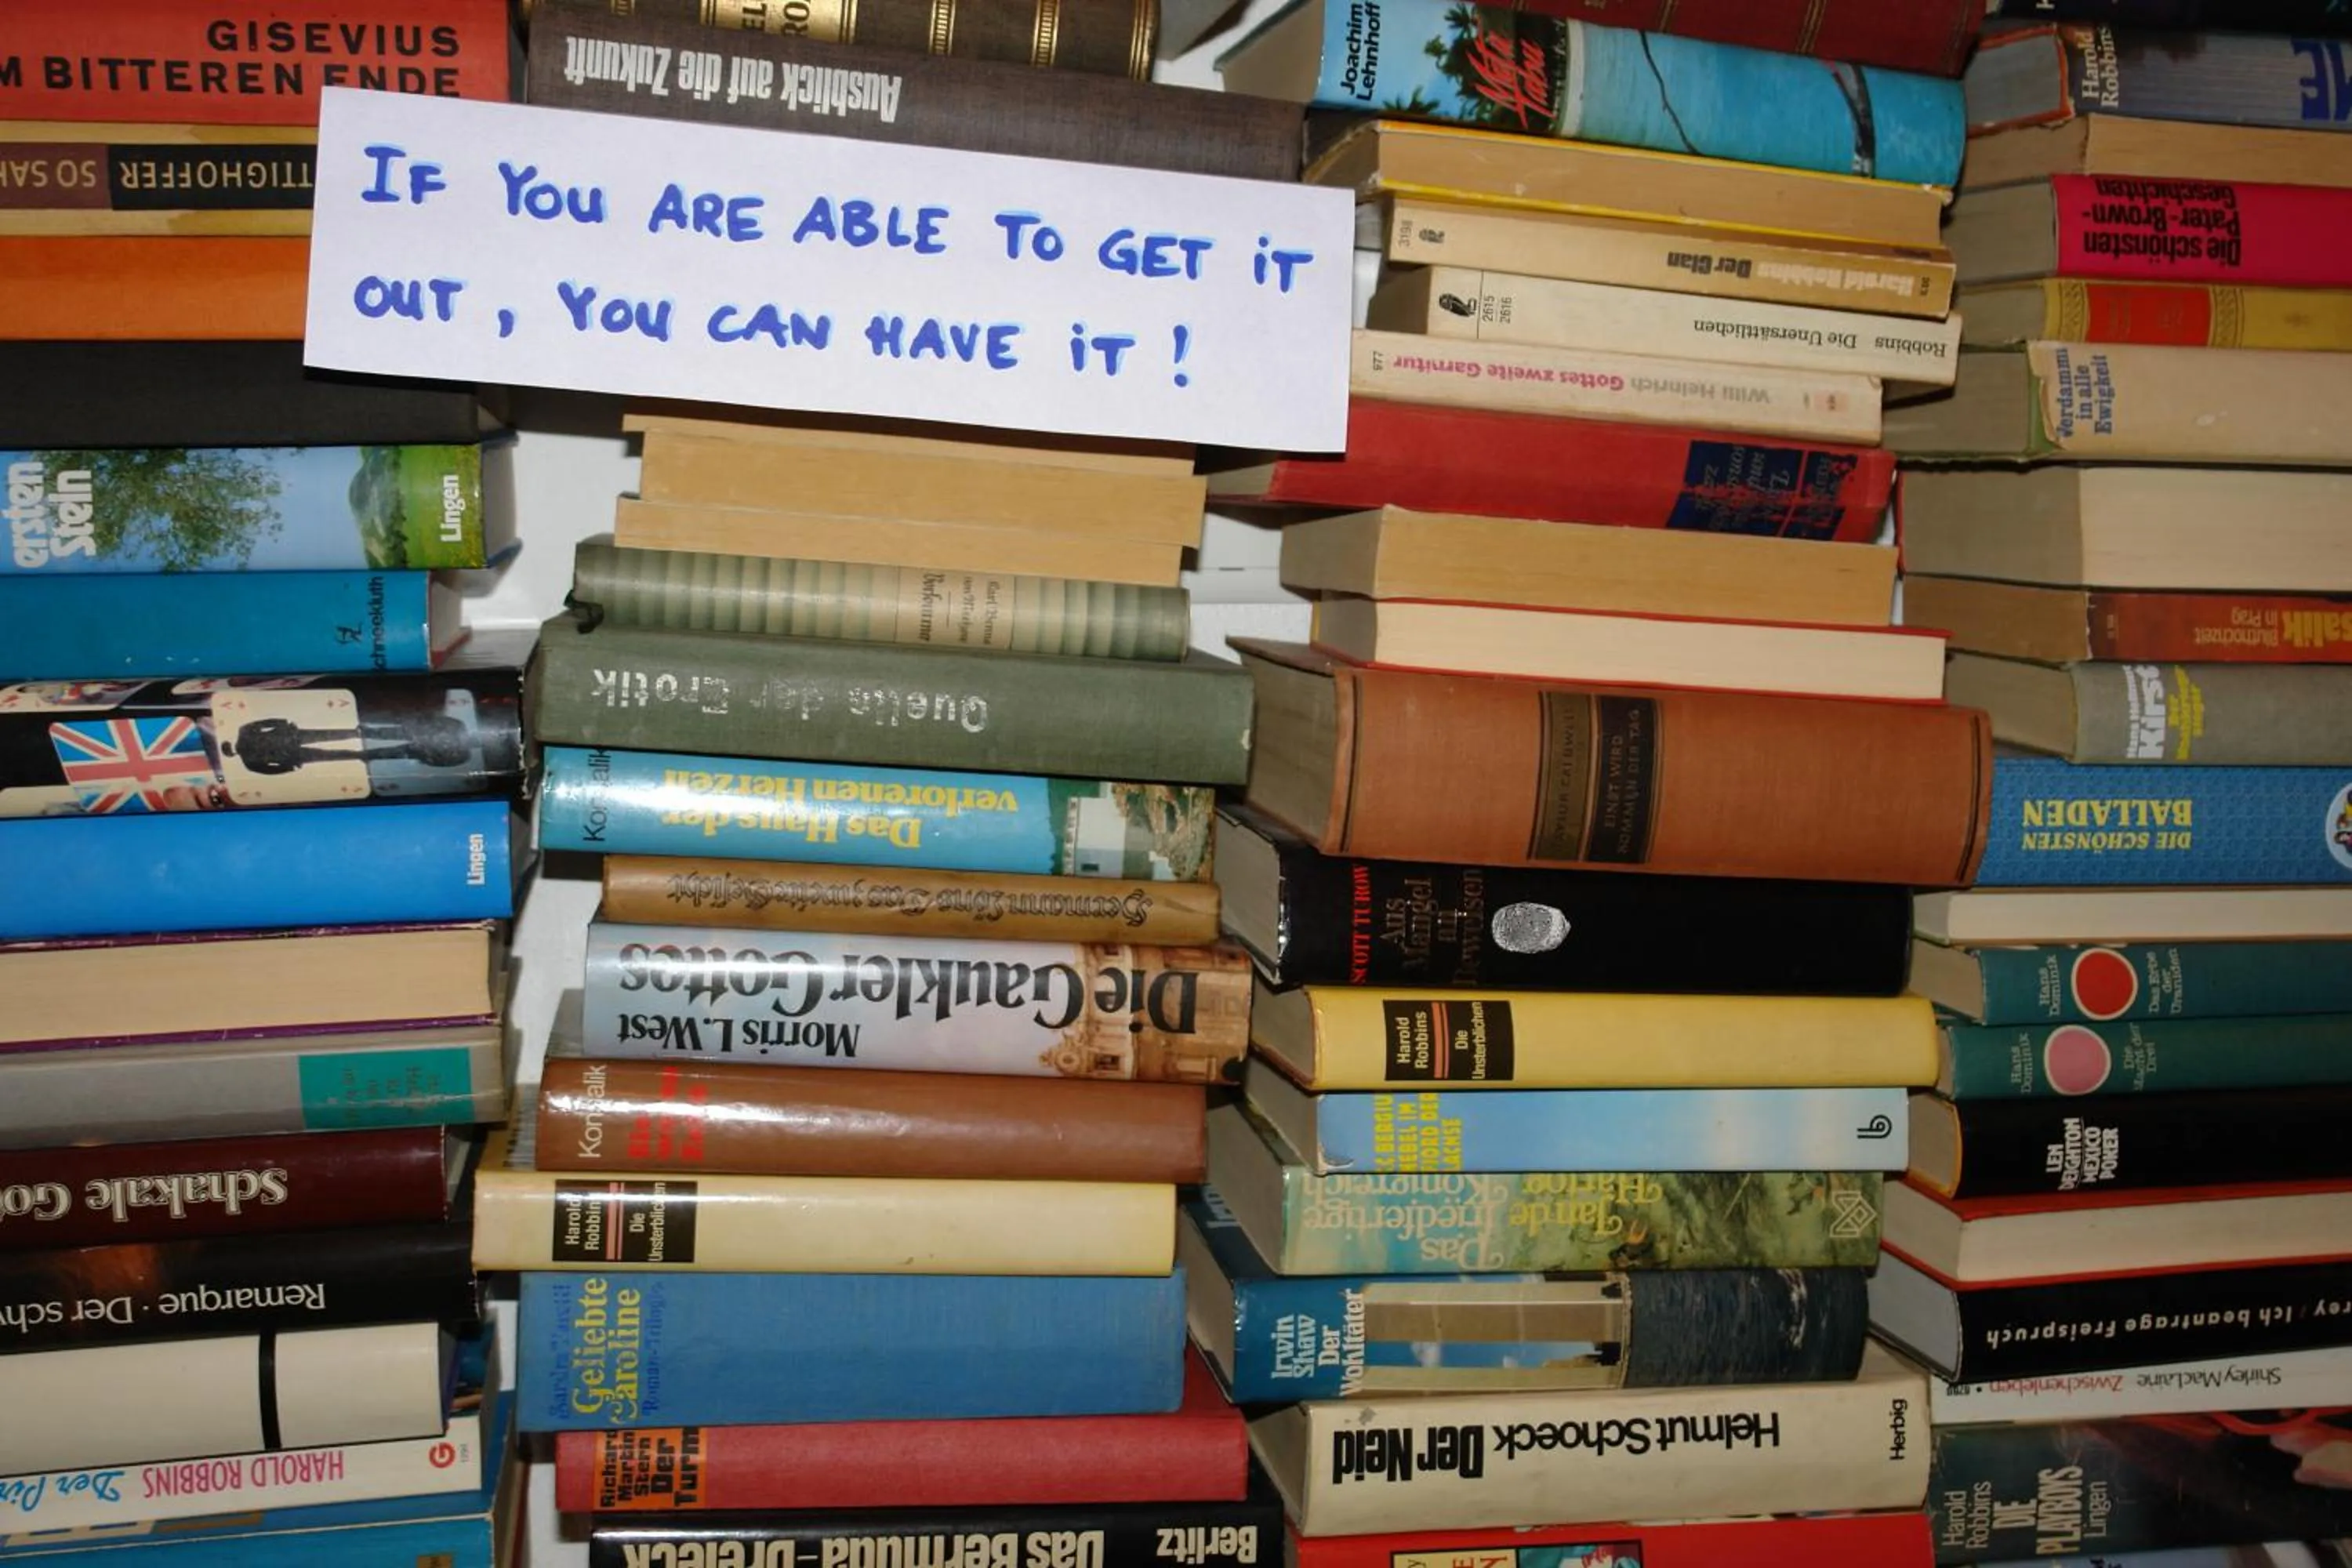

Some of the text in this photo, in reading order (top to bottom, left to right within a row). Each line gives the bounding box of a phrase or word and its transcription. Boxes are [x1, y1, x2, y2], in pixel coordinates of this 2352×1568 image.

[207, 20, 460, 56] GISEVIUS
[1340, 3, 1363, 96] Joachim
[1356, 1, 1381, 101] Lehnhoff
[45, 58, 460, 96] BITTEREN ENDE
[564, 36, 902, 123] Ausblick auf die Zukunft
[2075, 31, 2100, 99] Harold
[2098, 27, 2119, 107] Robbins
[56, 161, 97, 187] SO
[2093, 178, 2236, 210] Geschichten
[361, 144, 448, 205] IF
[648, 183, 764, 242] ARE
[794, 196, 949, 255] ABLE
[995, 213, 1064, 261] TO
[1098, 228, 1213, 280] GET
[1714, 256, 1752, 280] Der
[2083, 230, 2241, 267] Die schönsten
[1482, 296, 1495, 321] 2615
[707, 304, 831, 350] CAN
[865, 316, 1020, 369] HAVE
[1693, 320, 1946, 358] Robbins Die Unersättlichen
[1392, 355, 1481, 379] Garnitur
[1486, 365, 1555, 383] zweite
[1558, 371, 1625, 392] Gottes
[1629, 376, 1716, 401] Heinrich
[2075, 401, 2093, 420] in
[2090, 355, 2115, 435] Ewigkeit
[2, 461, 49, 568] ersten
[440, 474, 466, 542] Lingen
[591, 669, 729, 714] Erotik
[583, 749, 612, 841] Konalik
[664, 770, 1018, 817] verlorenen Herzen
[2022, 800, 2192, 827] BALLADEN
[661, 809, 921, 848] Das Haus der
[2022, 832, 2192, 854] DIE SCHÖNSTEN
[466, 834, 487, 885] Lingen
[1350, 865, 1372, 984] SCOTT TUROW
[619, 943, 1199, 1035] Die Gaukler Gottes
[2039, 967, 2051, 1006] Hans
[2047, 954, 2060, 1016] Dominik
[742, 1020, 860, 1058] Morris
[1396, 1017, 1411, 1064] Harold
[1414, 1011, 1429, 1069] Robbins
[1454, 1029, 1468, 1050] Die
[1471, 1001, 1486, 1080] Unsterblichen
[2010, 1046, 2023, 1083] Hans
[2019, 1031, 2033, 1094] Dominik
[578, 1065, 607, 1158] Konalik
[2045, 1144, 2064, 1173] LEN
[2057, 1117, 2082, 1191] DEIGHTON
[2082, 1127, 2102, 1182] MEXICO
[2099, 1127, 2118, 1179] POKER
[0, 1168, 289, 1222] Schakale Go
[1303, 1174, 1509, 1208] Königreich
[584, 1195, 601, 1250] Robbin
[629, 1213, 646, 1233] Die
[70, 1296, 132, 1325] Der
[158, 1283, 326, 1315] Remarque
[2125, 1308, 2250, 1333] beantrage
[2259, 1305, 2293, 1327] Ich
[572, 1278, 615, 1414] Geliebte
[608, 1288, 641, 1425] Caroline
[1271, 1314, 1294, 1379] Irwin
[1292, 1314, 1316, 1378] Shaw
[1317, 1324, 1340, 1367] Der
[1338, 1288, 1366, 1396] Wohltäter
[1986, 1320, 2116, 1349] Freispruch
[1989, 1375, 2125, 1397] Zwischenleben
[1332, 1413, 1780, 1484] Helmut Schoeck Der Neid
[1889, 1399, 1908, 1461] Herbig
[55, 1450, 344, 1503] HAROLD ROBBINS Der
[633, 1438, 651, 1497] Stern
[651, 1438, 675, 1494] Der
[674, 1427, 700, 1507] Turm
[1942, 1490, 1967, 1546] Harold
[1965, 1481, 1991, 1549] Robbins
[1992, 1499, 2037, 1530] DIE
[2035, 1465, 2084, 1555] PLAYBOYS
[2084, 1481, 2112, 1537] Lingen
[1026, 1528, 1105, 1568] Das
[1156, 1525, 1258, 1565] Berlitz
